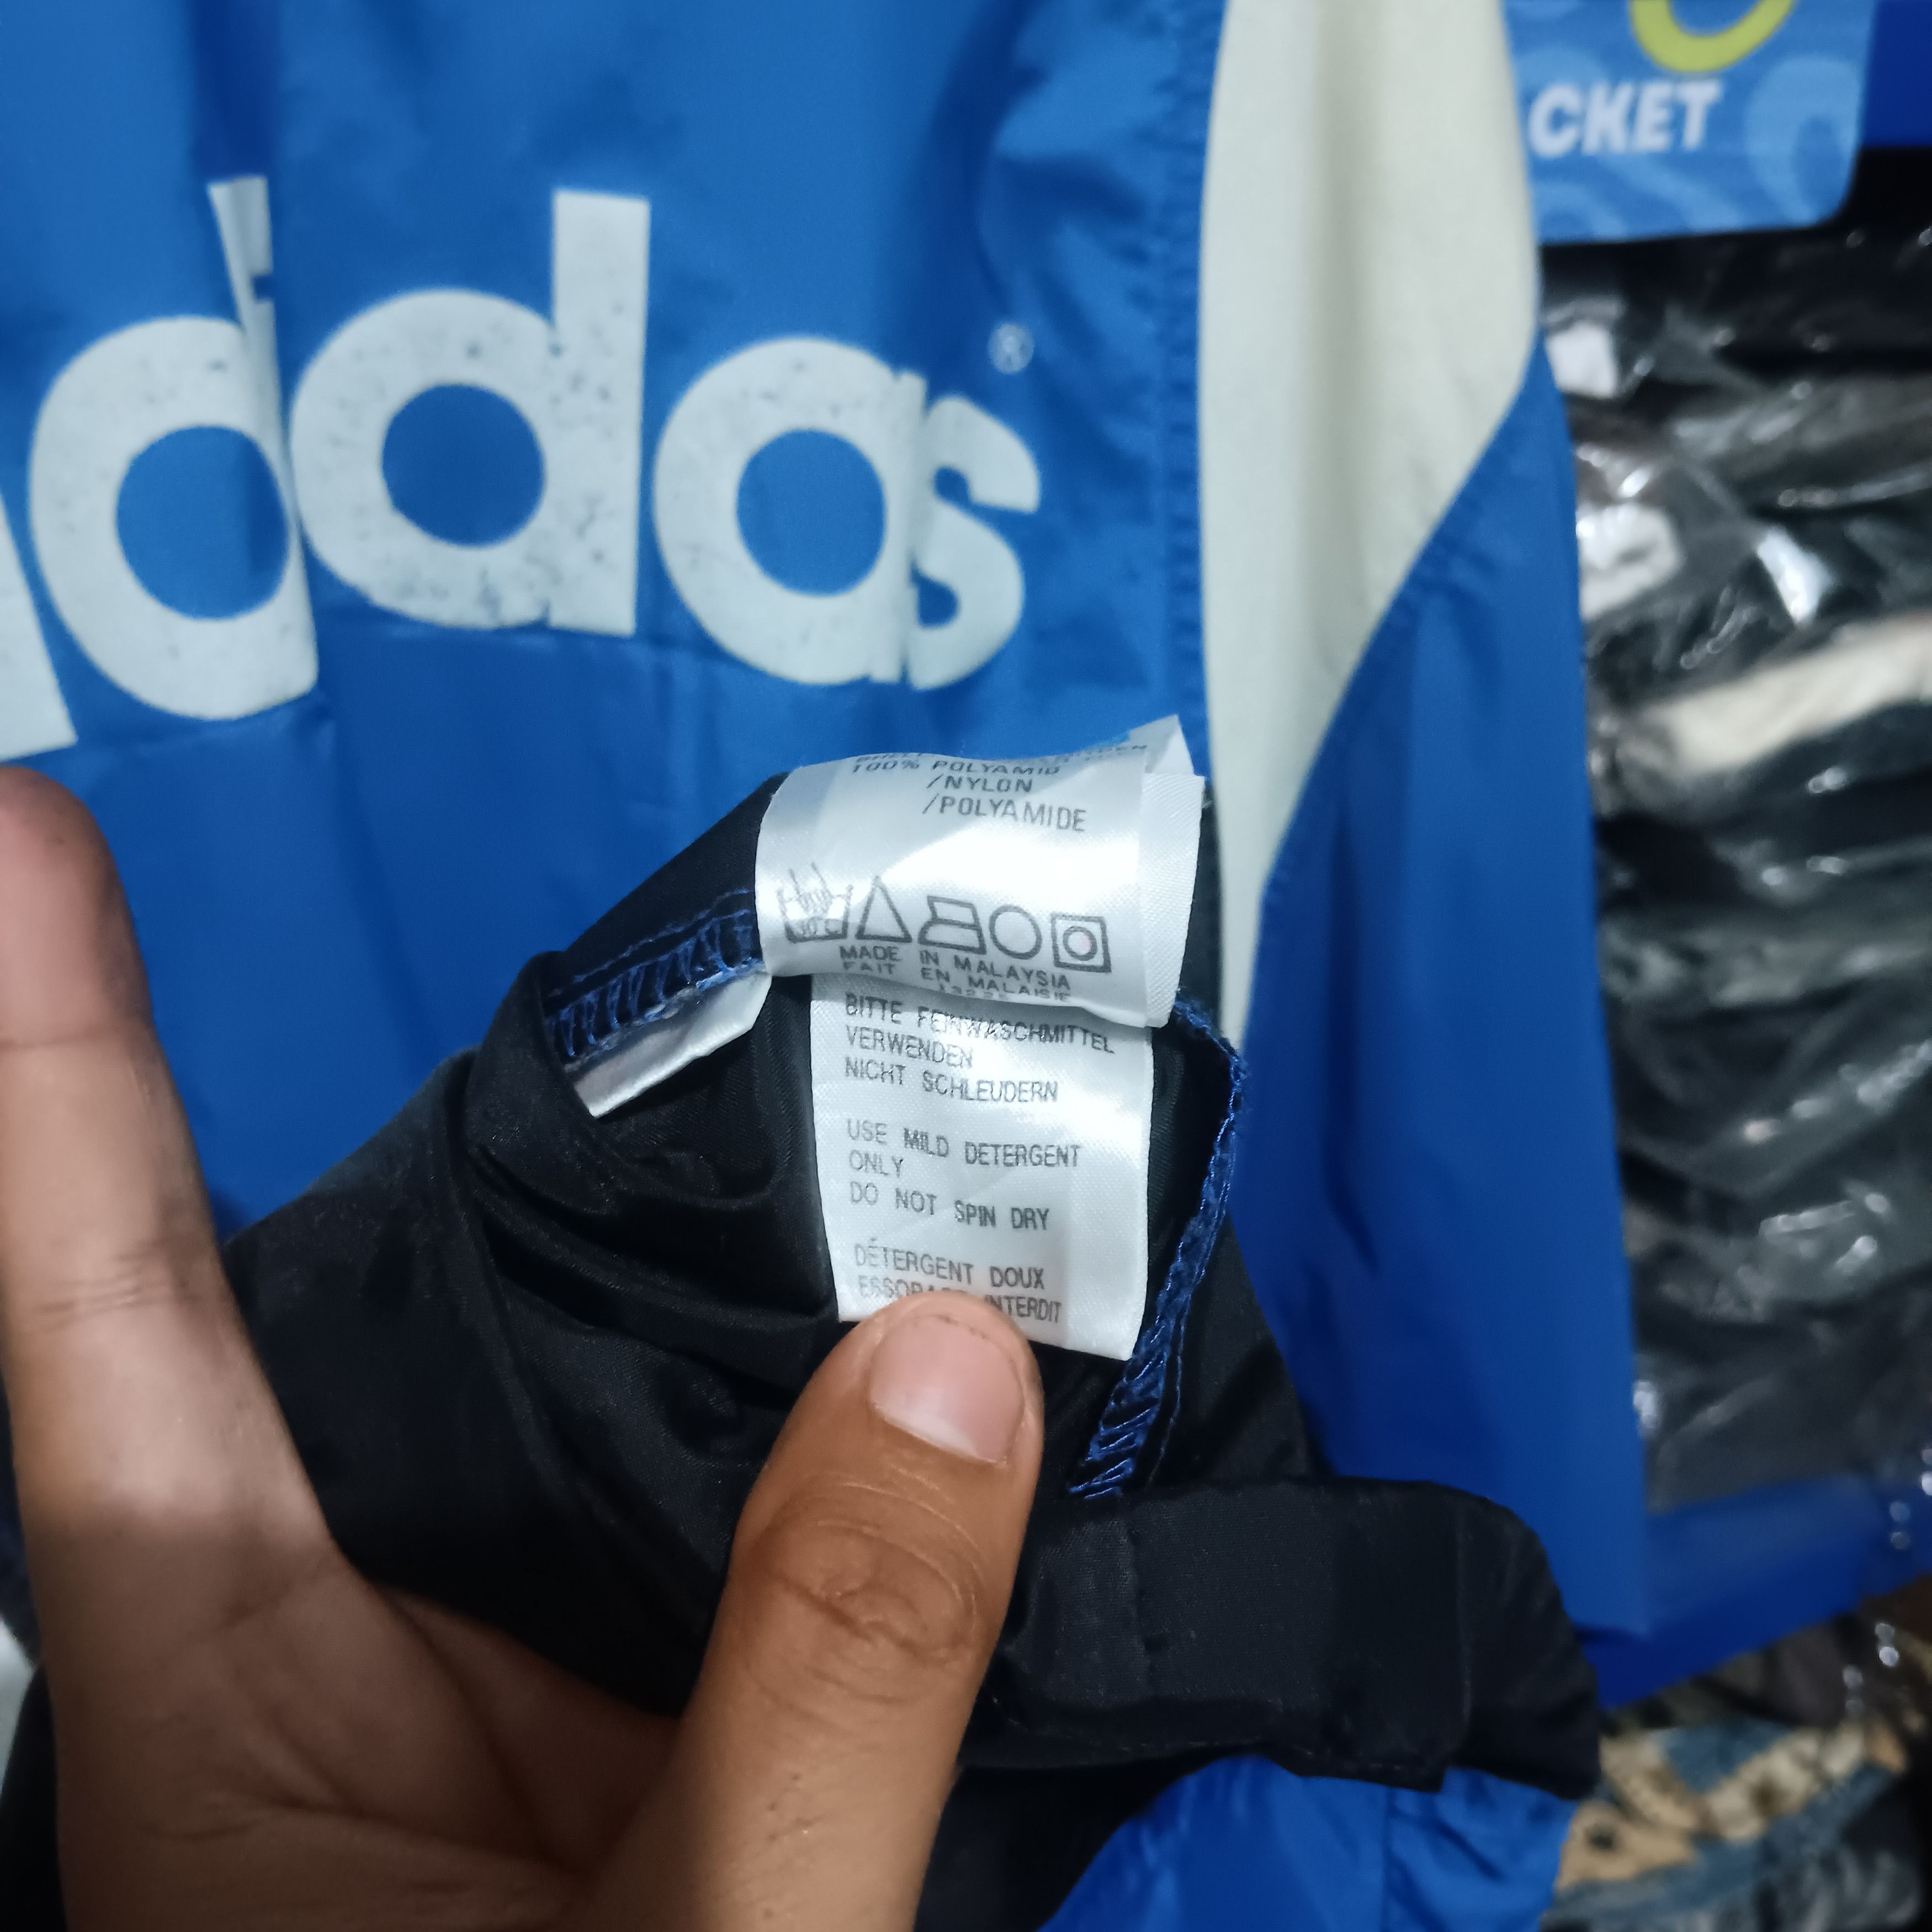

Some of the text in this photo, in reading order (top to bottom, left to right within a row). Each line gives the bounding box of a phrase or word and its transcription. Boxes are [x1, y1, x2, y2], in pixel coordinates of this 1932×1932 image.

[852, 760, 920, 774] 100%
[926, 773, 1032, 793] /NYLON
[922, 793, 1087, 832] /POLYAMIDE
[839, 945, 901, 962] MADE
[920, 949, 940, 966] IN
[954, 954, 1071, 990] MALAYSIA
[921, 967, 950, 983] EN
[845, 992, 903, 1025] BITTE
[846, 1025, 974, 1068] VERWENDEN
[845, 1057, 1059, 1102] NICHT SCHLEUDERN
[847, 1119, 1082, 1167] USE MILD DETERGENT
[848, 1149, 904, 1177] ONLY
[850, 1182, 1049, 1230] DO NOT SPIN DRY
[854, 1236, 1045, 1290] DÉTERGENT DOUX
